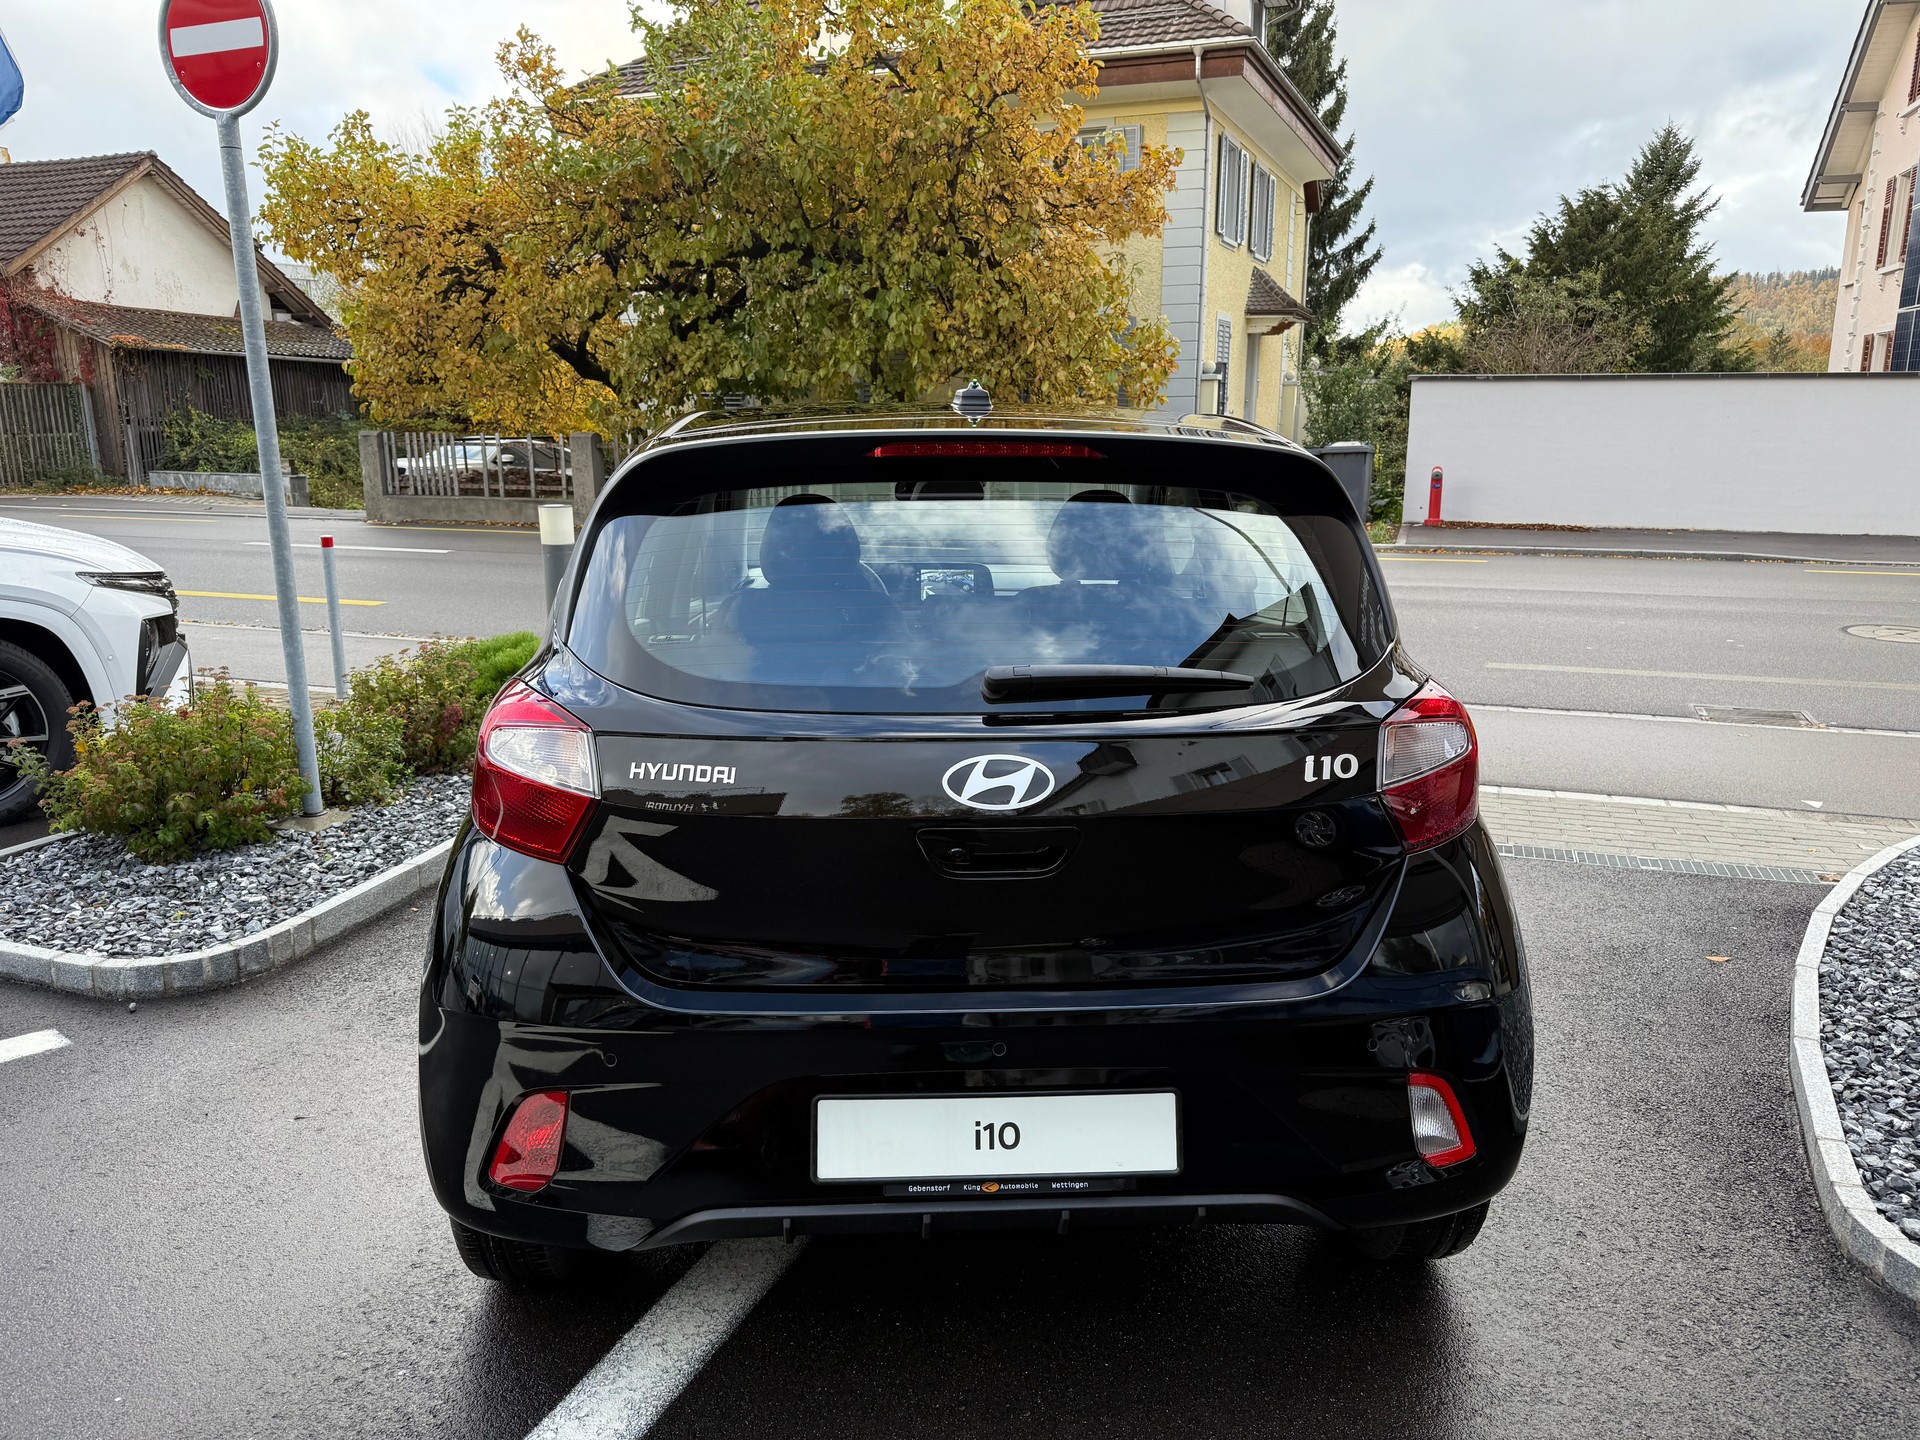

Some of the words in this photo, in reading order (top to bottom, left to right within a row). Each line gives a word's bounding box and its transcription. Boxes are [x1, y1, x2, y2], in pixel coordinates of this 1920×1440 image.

[629, 762, 737, 784] HYUNDAI
[1304, 753, 1359, 783] i10
[974, 1121, 1021, 1151] i10
[908, 1184, 951, 1192] Gebenstorf
[1051, 1181, 1089, 1189] Wettingen
